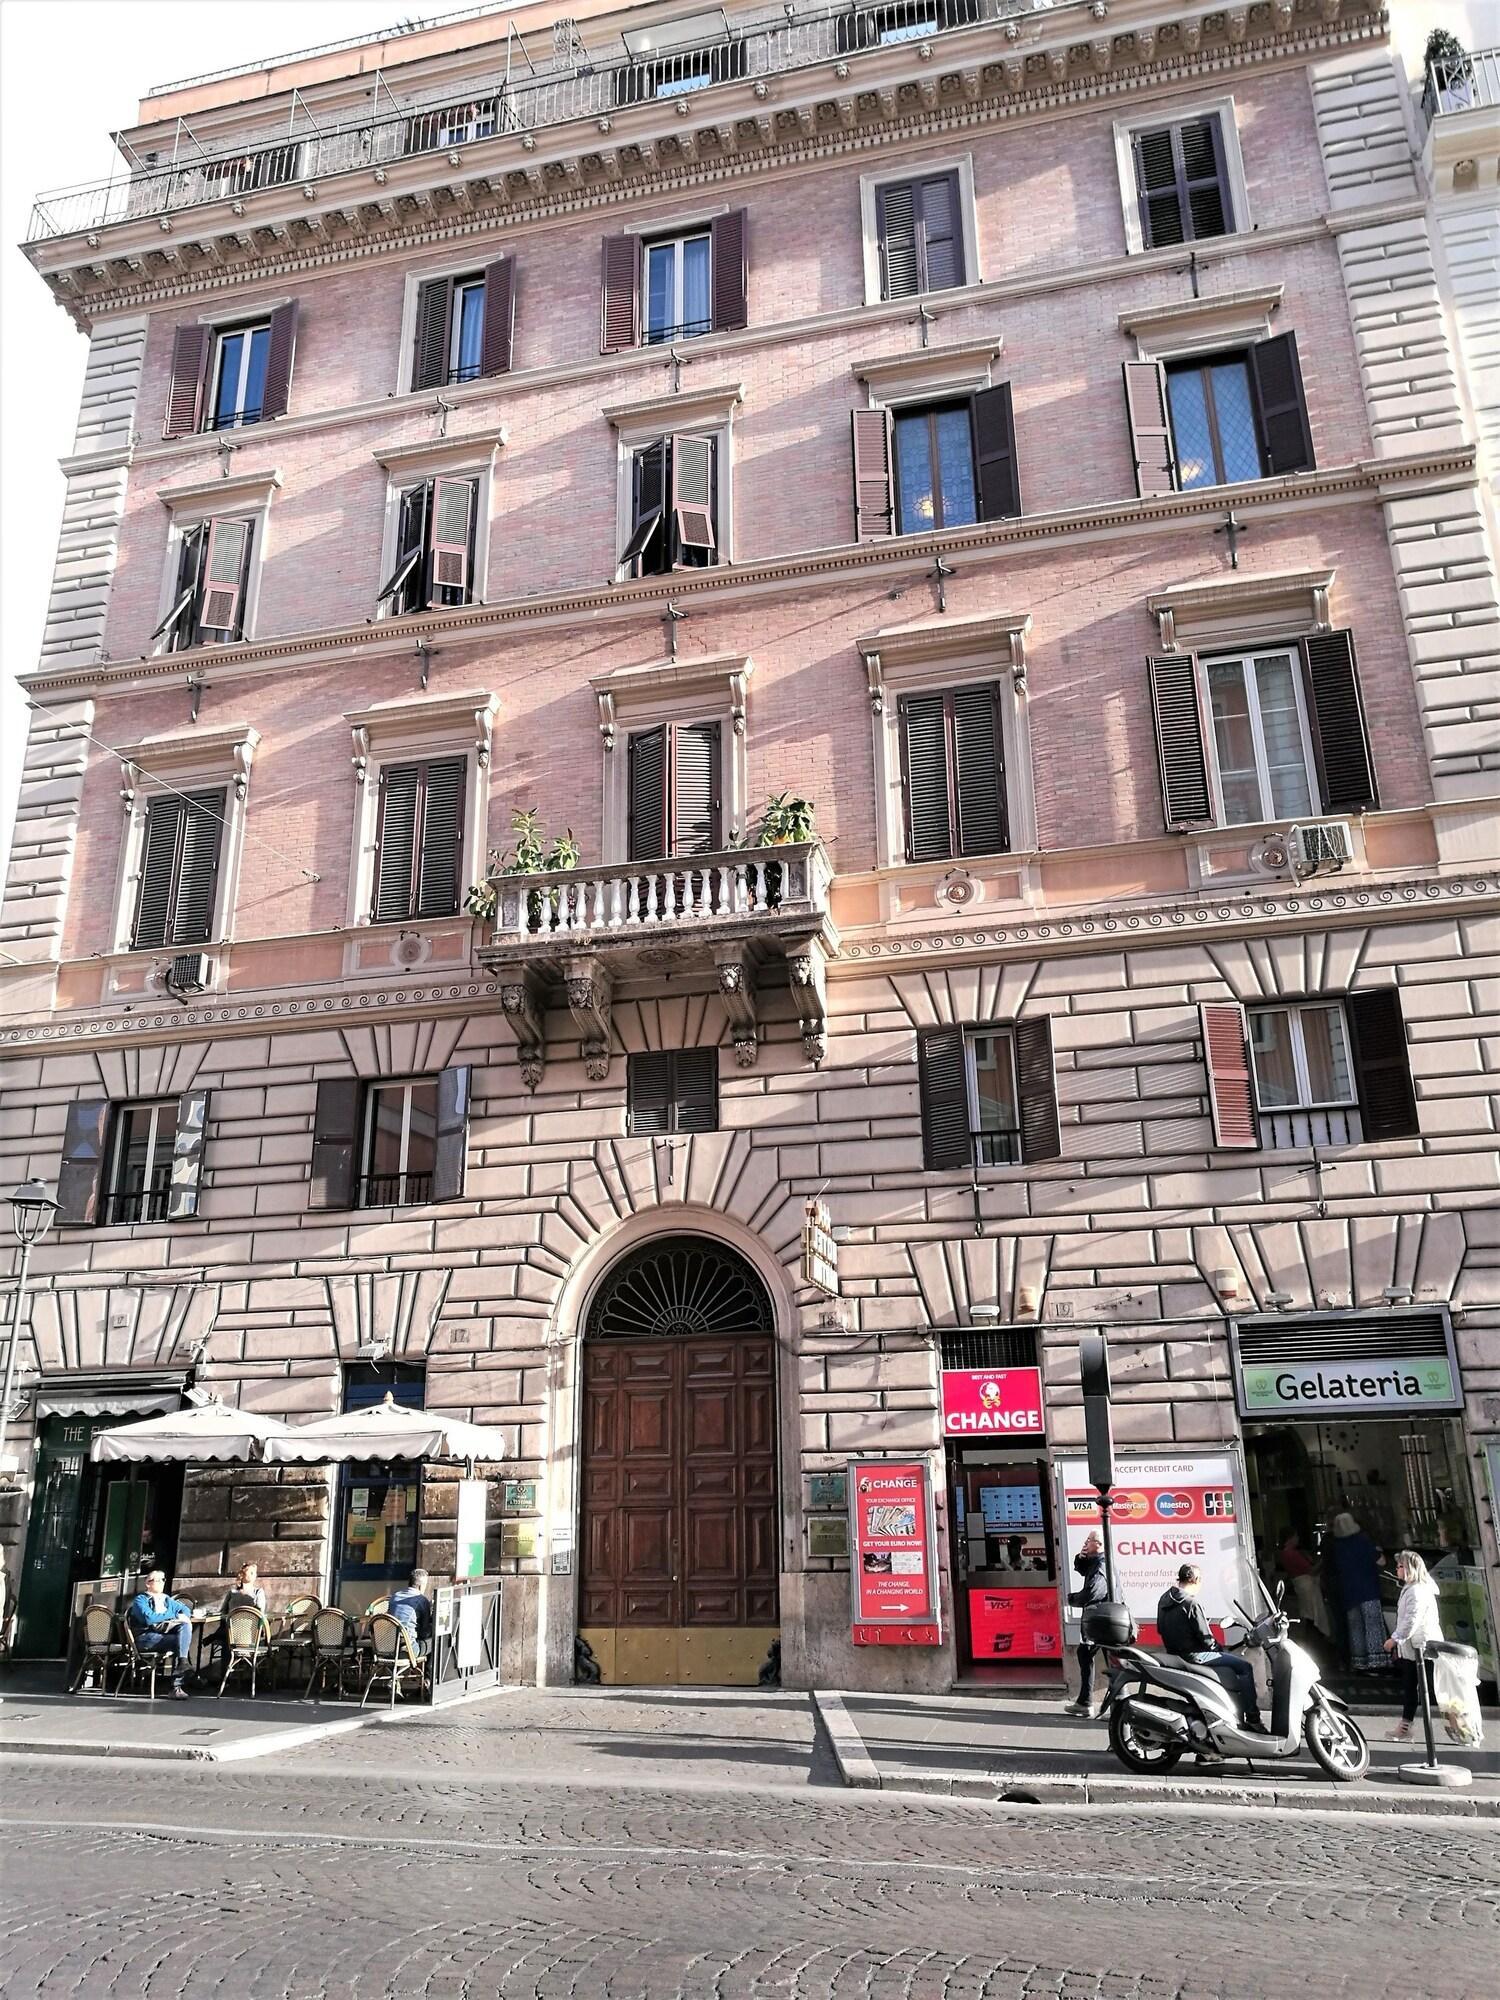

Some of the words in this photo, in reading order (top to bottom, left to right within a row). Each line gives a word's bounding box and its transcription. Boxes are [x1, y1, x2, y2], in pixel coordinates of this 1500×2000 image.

[1275, 1370, 1423, 1401] Gelateria
[946, 1410, 1040, 1430] CHANGE
[63, 1426, 85, 1442] THE
[1144, 1465, 1170, 1473] CREDIT
[873, 1480, 917, 1488] CHANGE
[1073, 1502, 1092, 1510] VISA
[1112, 1501, 1148, 1510] MasterCard
[1159, 1501, 1190, 1509] Maestro
[1117, 1541, 1206, 1555] CHANGE
[1159, 1569, 1173, 1577] fast
